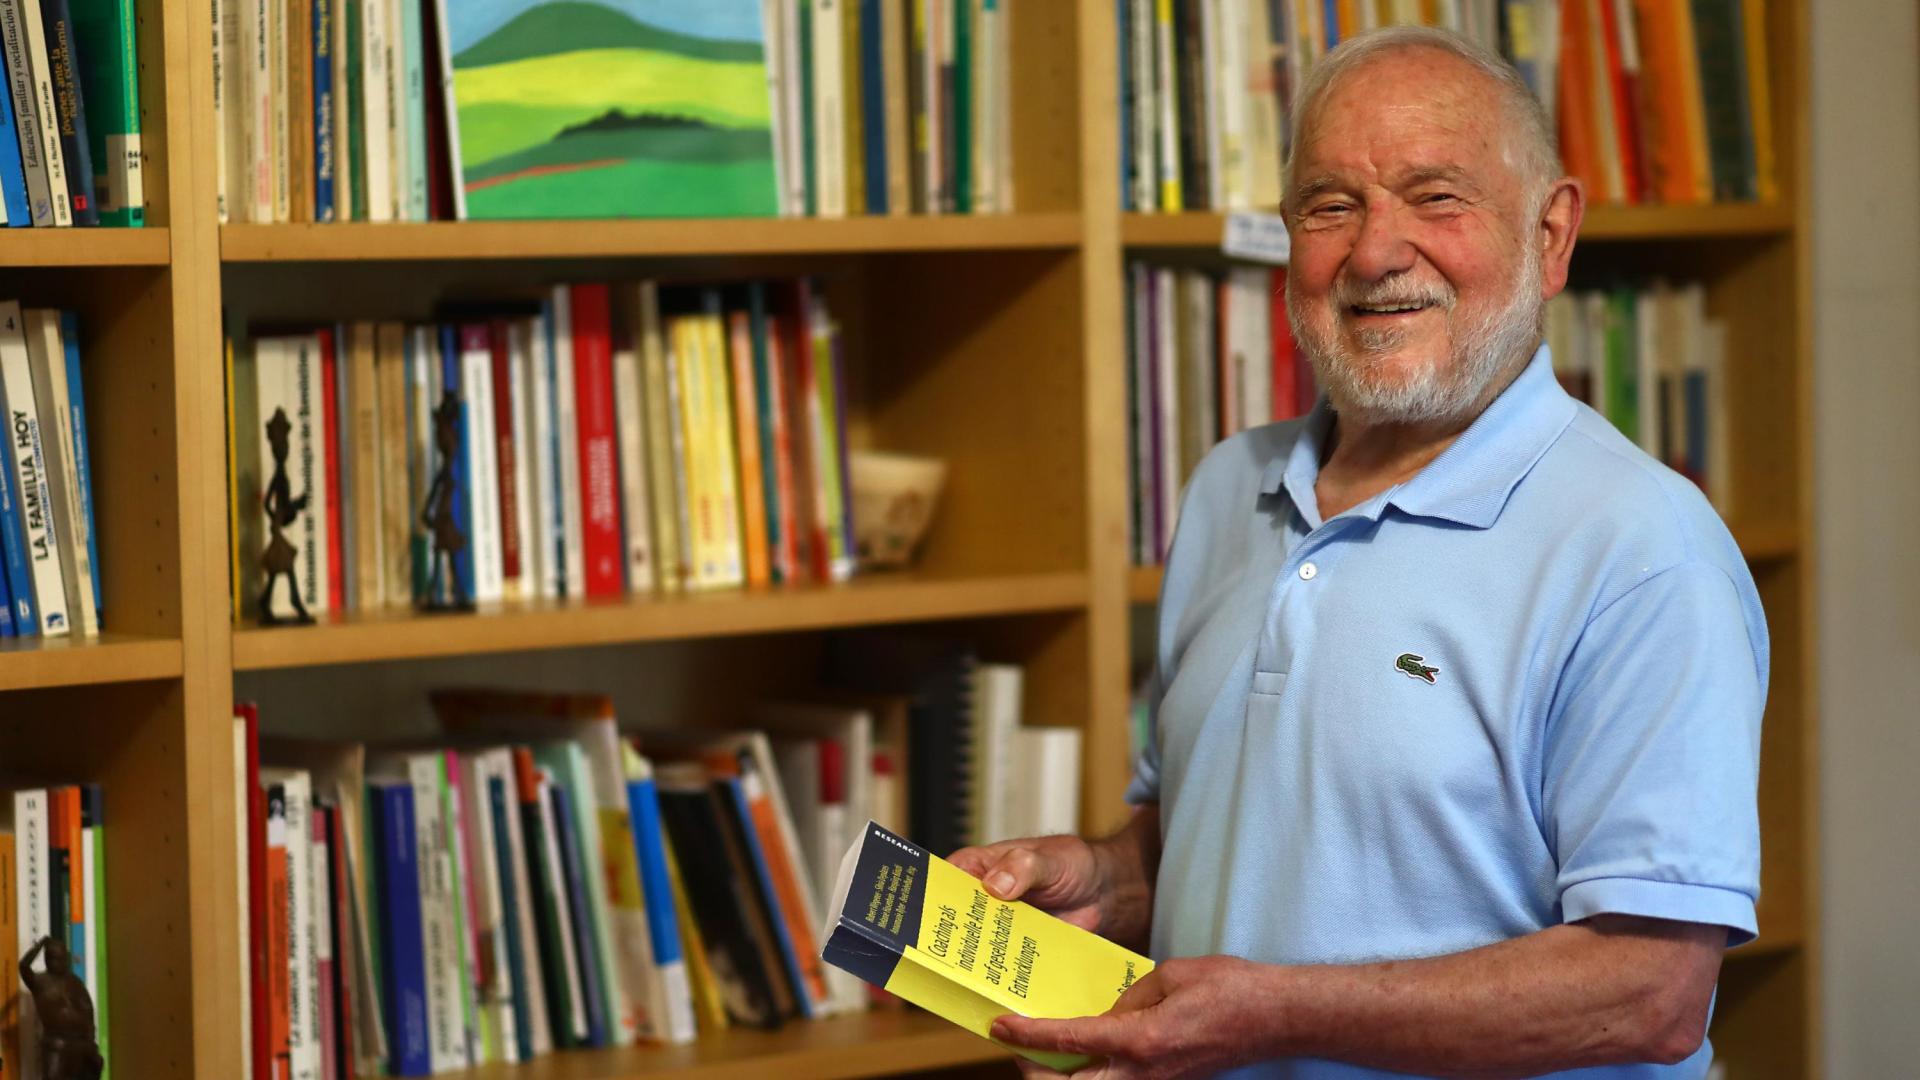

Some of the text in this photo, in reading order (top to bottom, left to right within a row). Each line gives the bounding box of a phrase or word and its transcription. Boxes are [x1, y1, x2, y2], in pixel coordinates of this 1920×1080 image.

[5, 8, 21, 69] socialización
[55, 21, 72, 79] economía
[15, 80, 34, 119] familiar
[55, 64, 65, 87] ante
[13, 410, 49, 560] LA FAMILIA HOY
[874, 829, 920, 857] RESEARCH
[928, 904, 959, 958] Coaching als
[955, 888, 989, 972] individuelle Antwort
[983, 904, 1015, 985] auf gesellschaftliche
[1007, 936, 1040, 999] Entwicklungen
